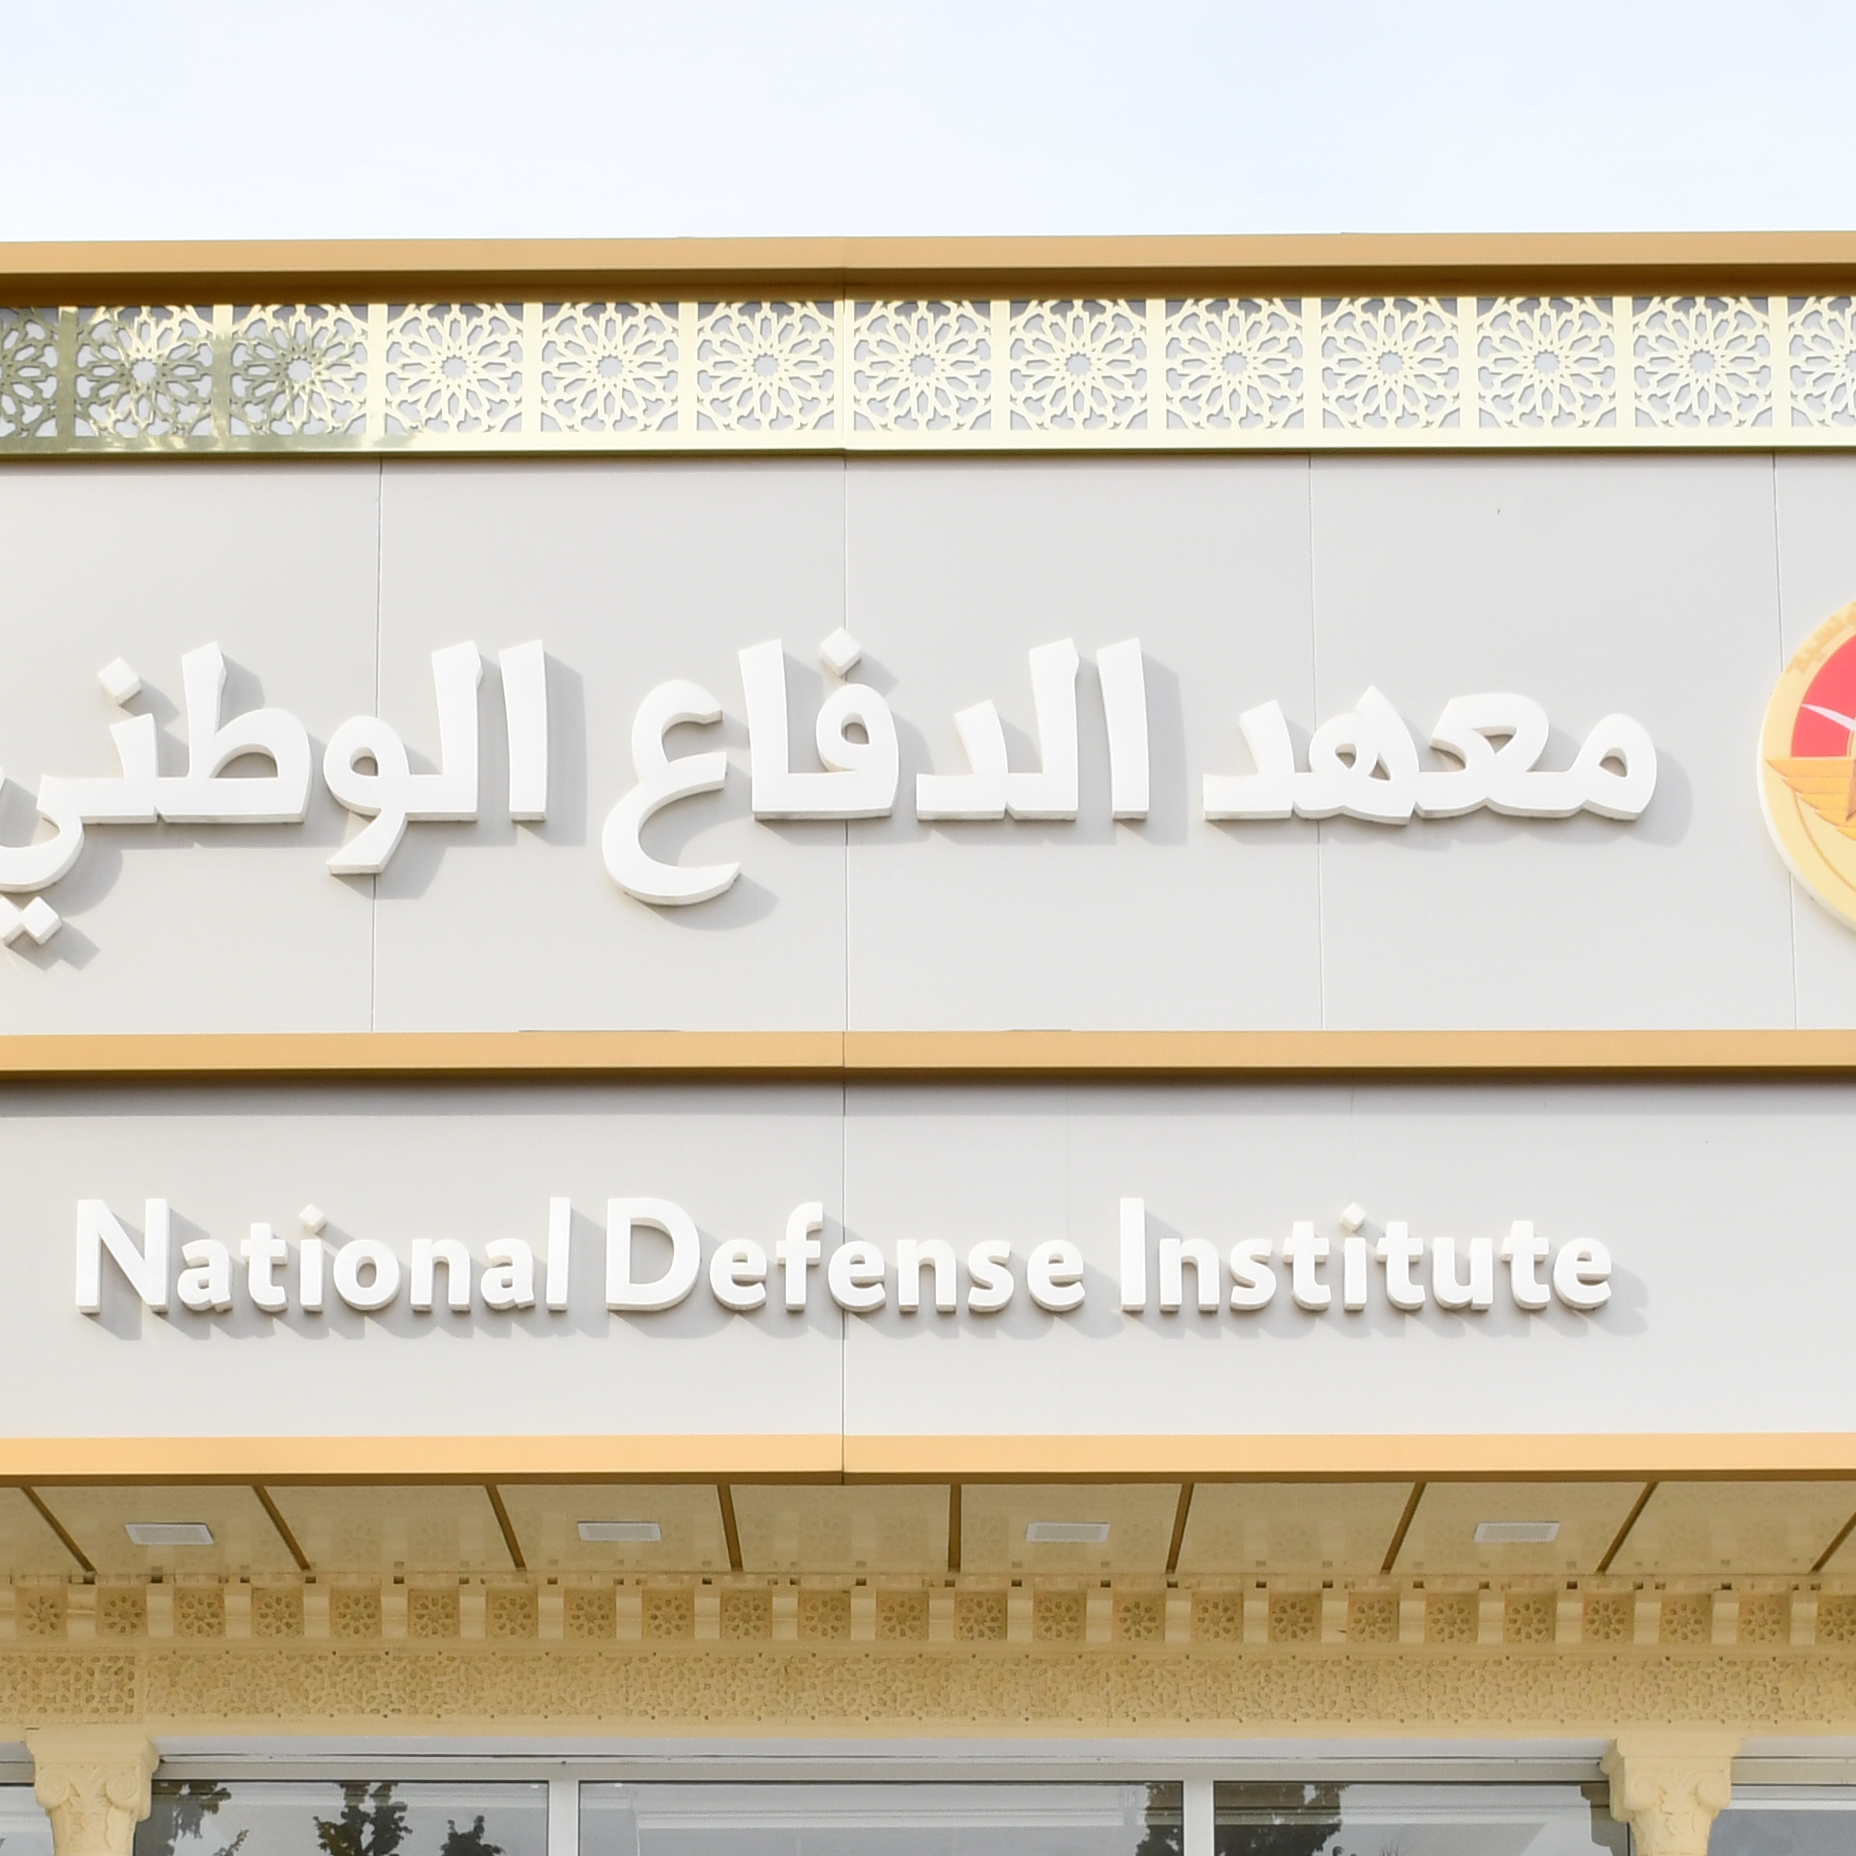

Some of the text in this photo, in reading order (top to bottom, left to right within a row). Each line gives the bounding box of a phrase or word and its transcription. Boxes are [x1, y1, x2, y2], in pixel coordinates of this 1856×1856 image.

[602, 627, 1145, 907] الدفاع
[1202, 684, 1657, 824] معهد
[74, 1197, 1612, 1315] National Defense Institute
